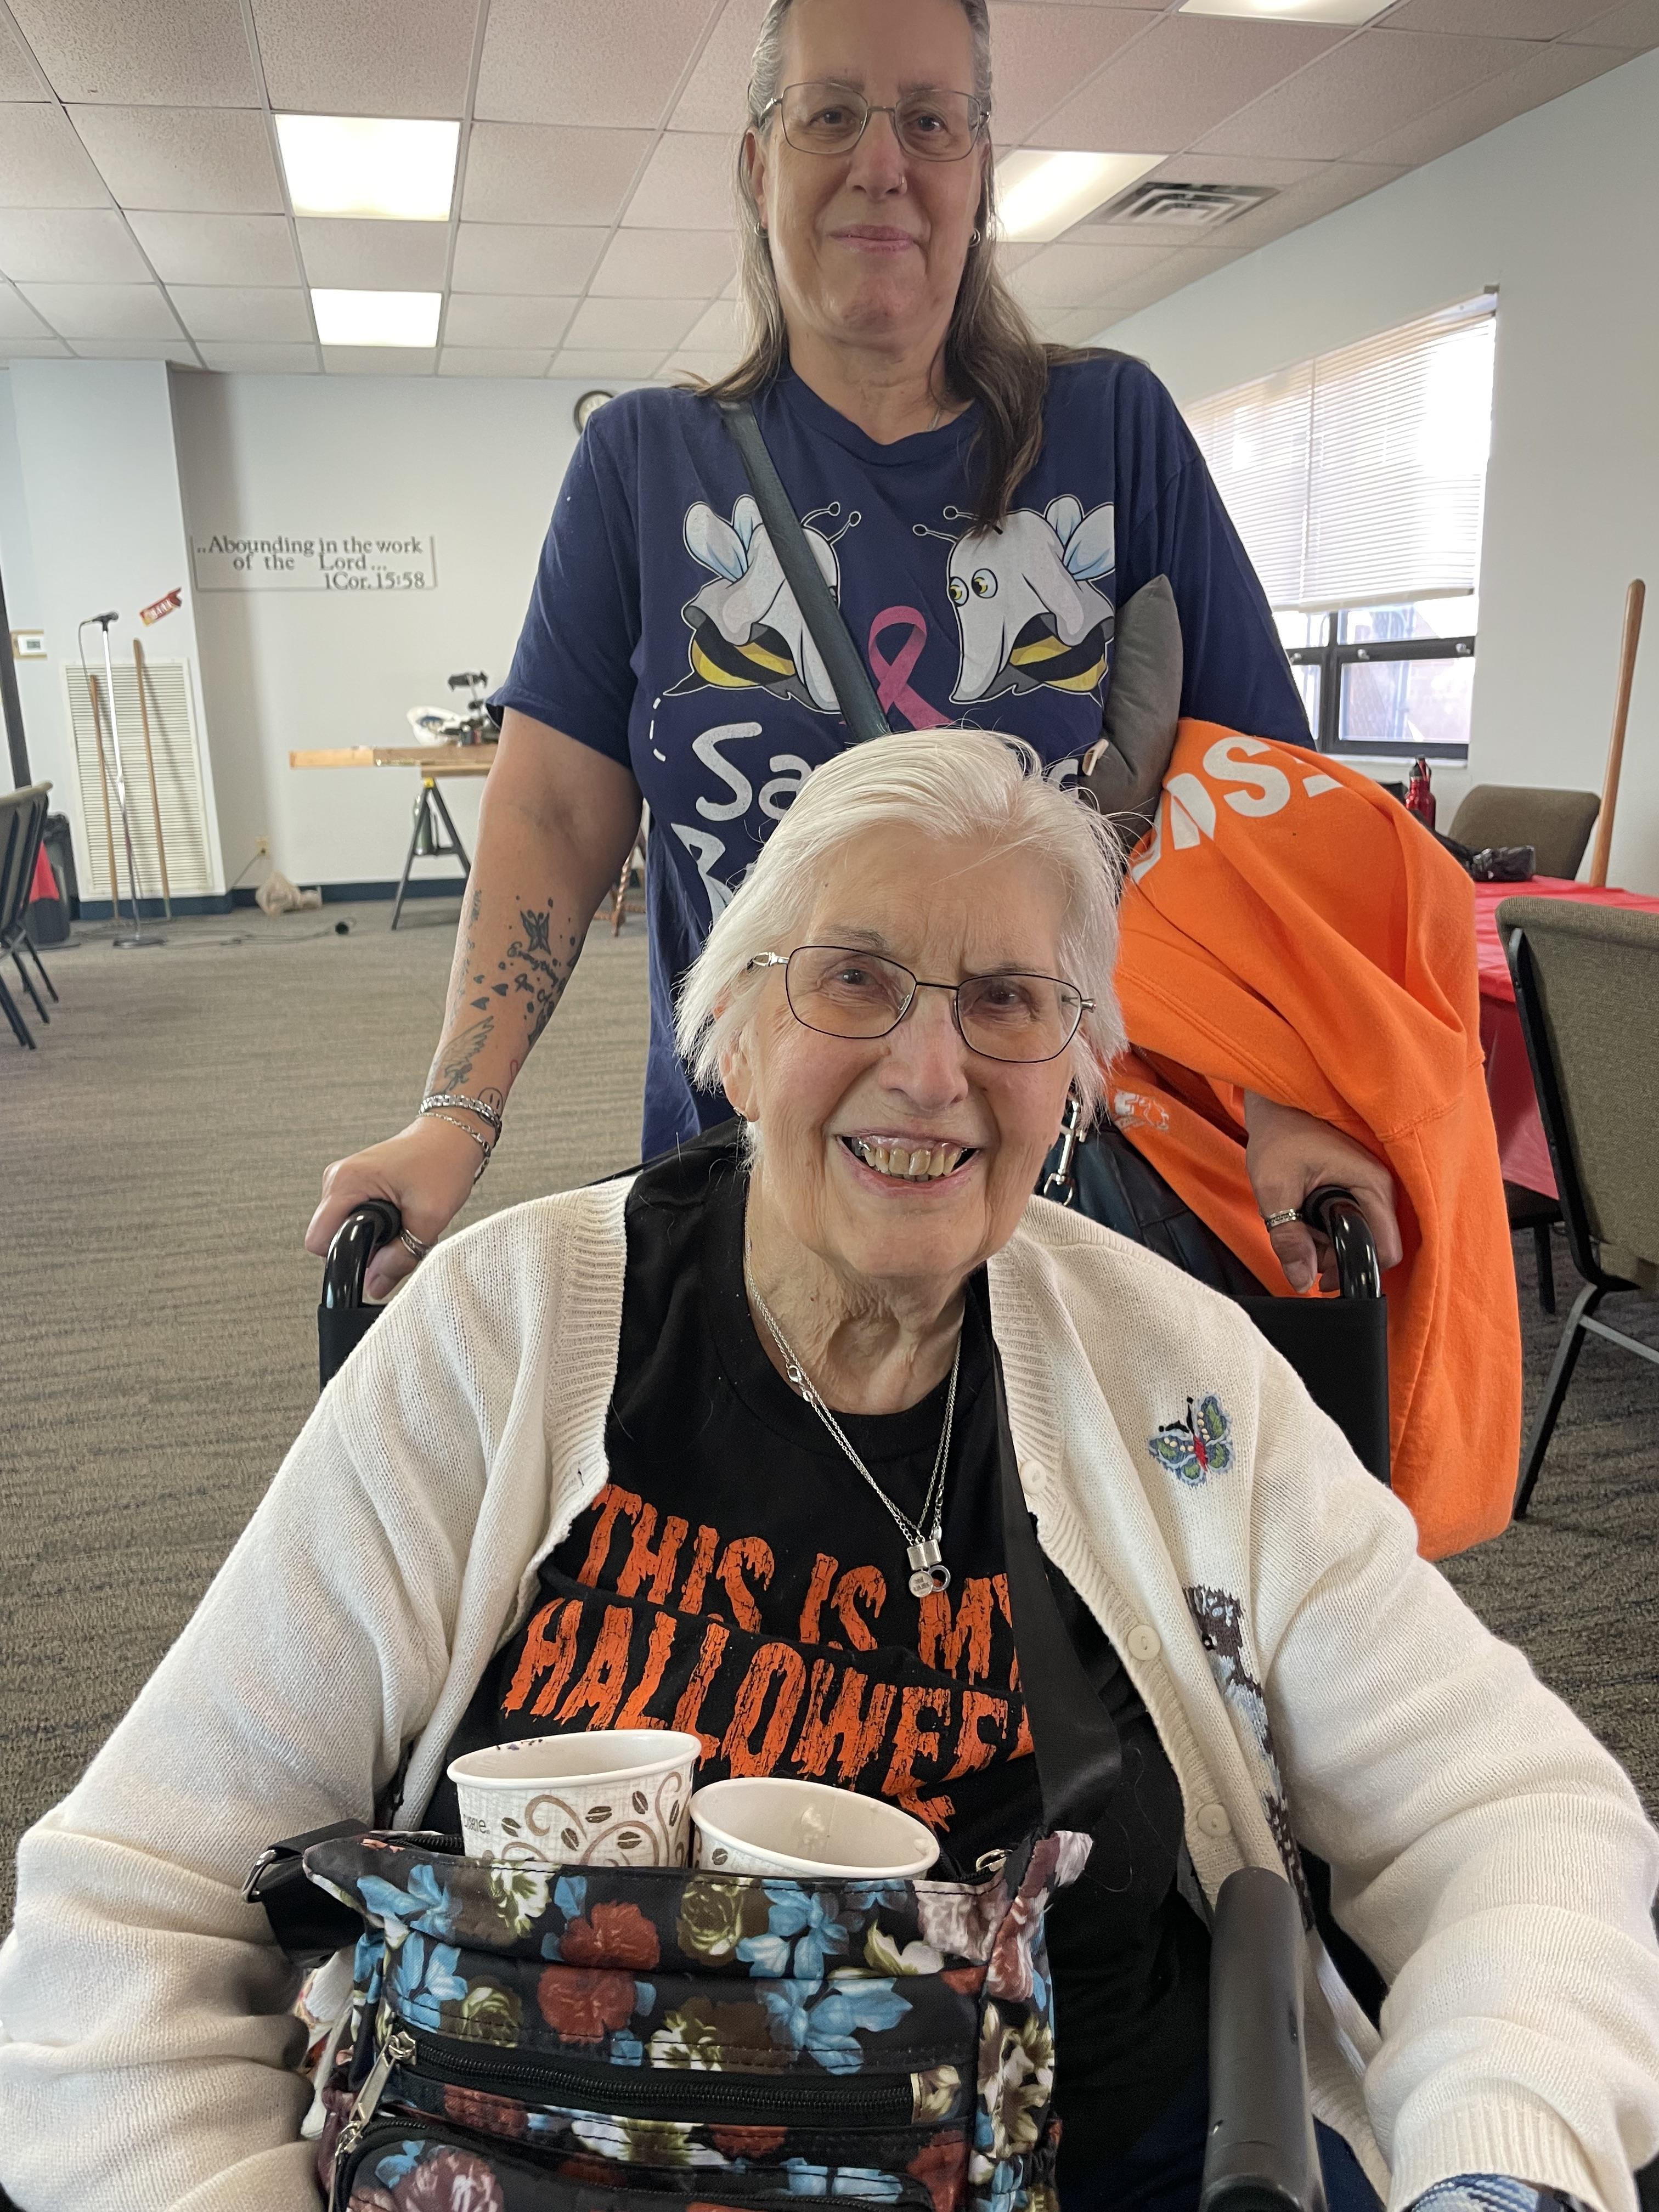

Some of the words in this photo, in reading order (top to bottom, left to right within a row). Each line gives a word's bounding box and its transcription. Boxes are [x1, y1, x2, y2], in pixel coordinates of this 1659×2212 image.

[233, 552, 254, 571] of
[264, 553, 295, 571] the
[319, 537, 337, 554] in
[343, 535, 373, 554] the
[376, 535, 424, 554] work
[376, 571, 425, 590] 15:58
[692, 721, 822, 821] Sa
[577, 1483, 775, 1634] THIS
[800, 1553, 887, 1651] IS
[500, 1597, 1035, 1831] HALLOWEE
